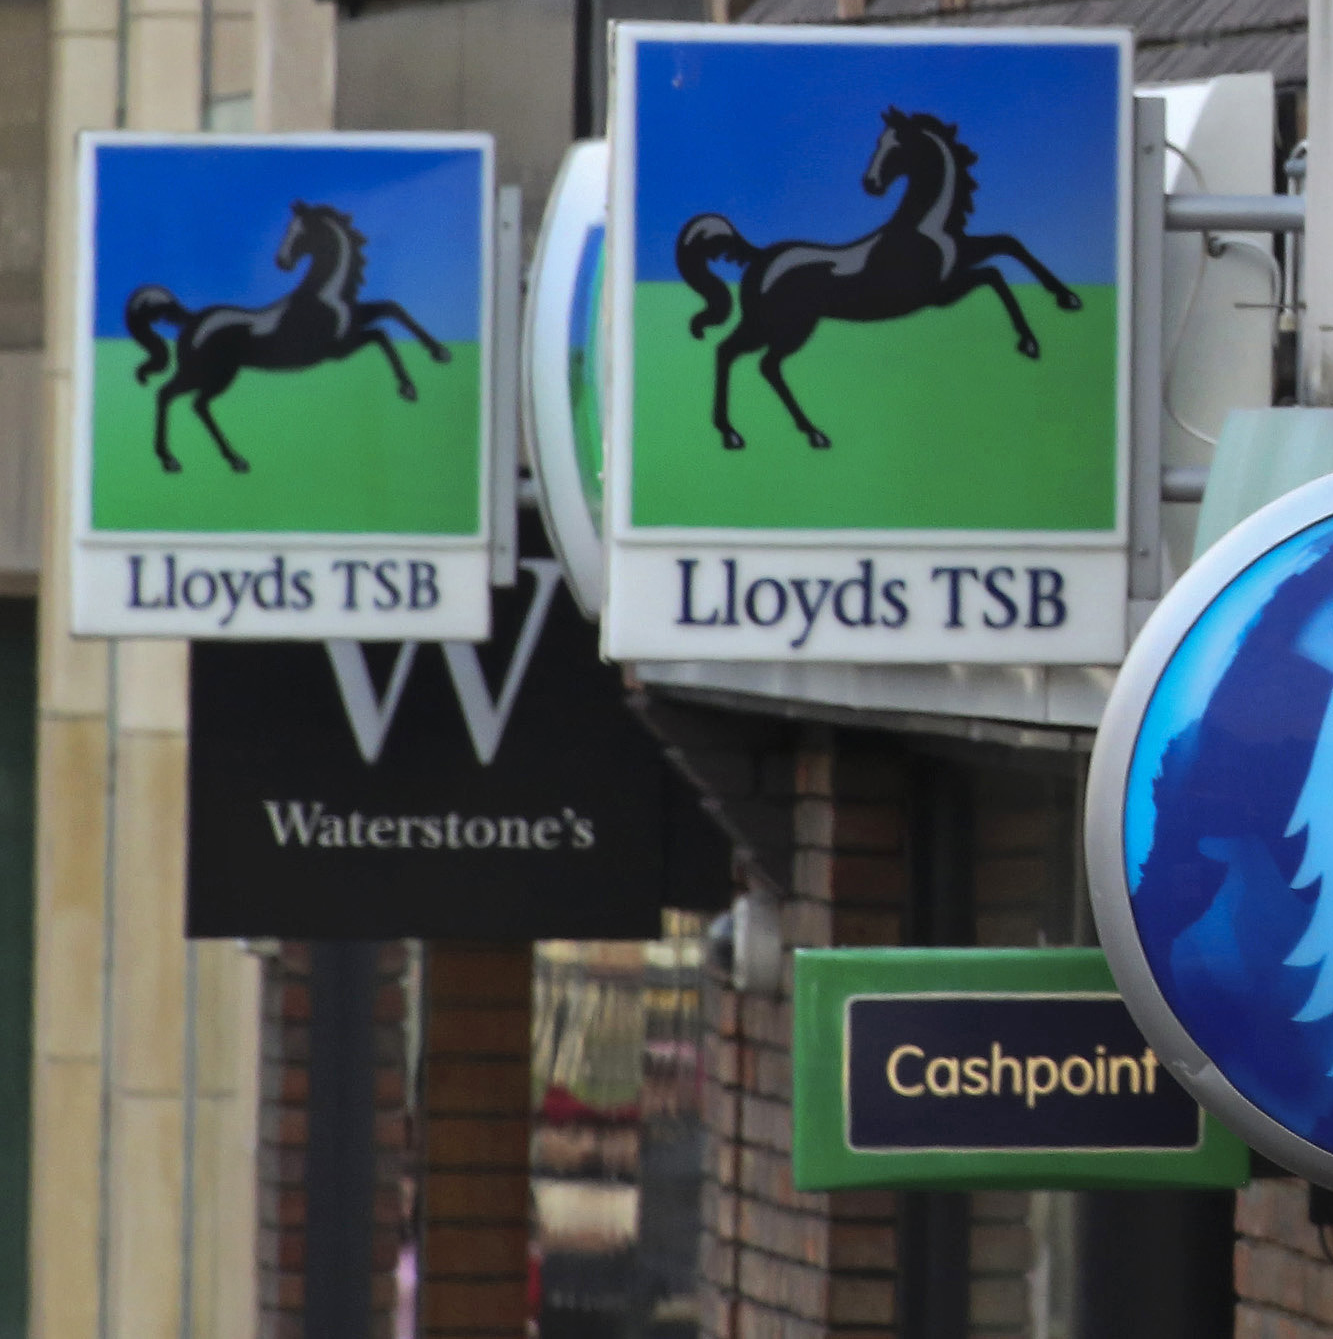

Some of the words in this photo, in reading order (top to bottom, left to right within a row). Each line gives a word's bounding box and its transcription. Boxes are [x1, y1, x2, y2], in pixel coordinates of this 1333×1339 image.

[126, 555, 314, 626] Lloyds
[332, 561, 441, 611] TSB
[674, 558, 909, 648] Lloyds
[931, 566, 1068, 629] TSB
[263, 799, 595, 850] Waterstone's
[885, 1042, 1159, 1108] Cashpoint
